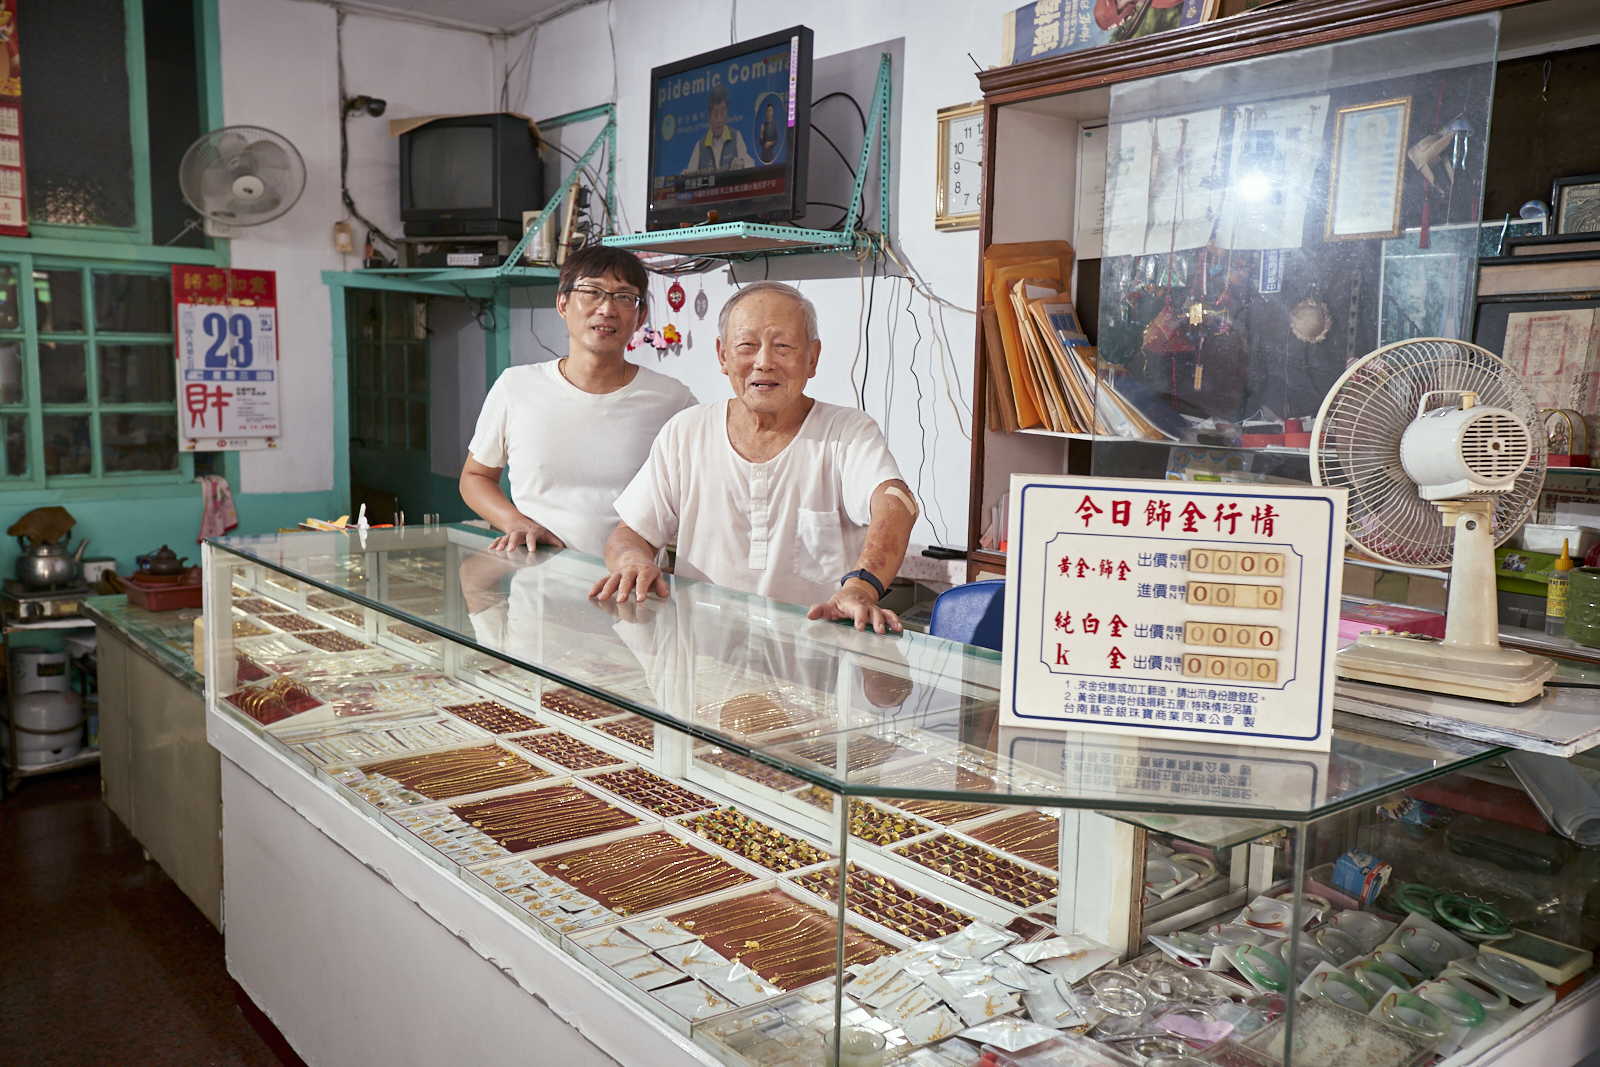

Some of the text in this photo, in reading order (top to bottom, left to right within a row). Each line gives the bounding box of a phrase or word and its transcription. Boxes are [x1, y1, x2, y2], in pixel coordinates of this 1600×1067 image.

[1078, 12, 1092, 42] HOME
[964, 126, 971, 138] 11
[954, 142, 964, 155] 10
[953, 162, 960, 174] 9
[954, 182, 961, 194] 8
[964, 193, 970, 205] 7
[202, 312, 254, 369] 23
[1074, 494, 1280, 538] 今日飾金行情
[1137, 551, 1168, 568] 出價
[1136, 582, 1167, 599] 進價
[1054, 610, 1128, 639] 純白金
[1134, 623, 1164, 640] 出價
[1106, 646, 1127, 670] 金
[1133, 654, 1163, 671] 出價
[1064, 703, 1255, 728] 台南縣金銀珠寶商業同業公會 製
